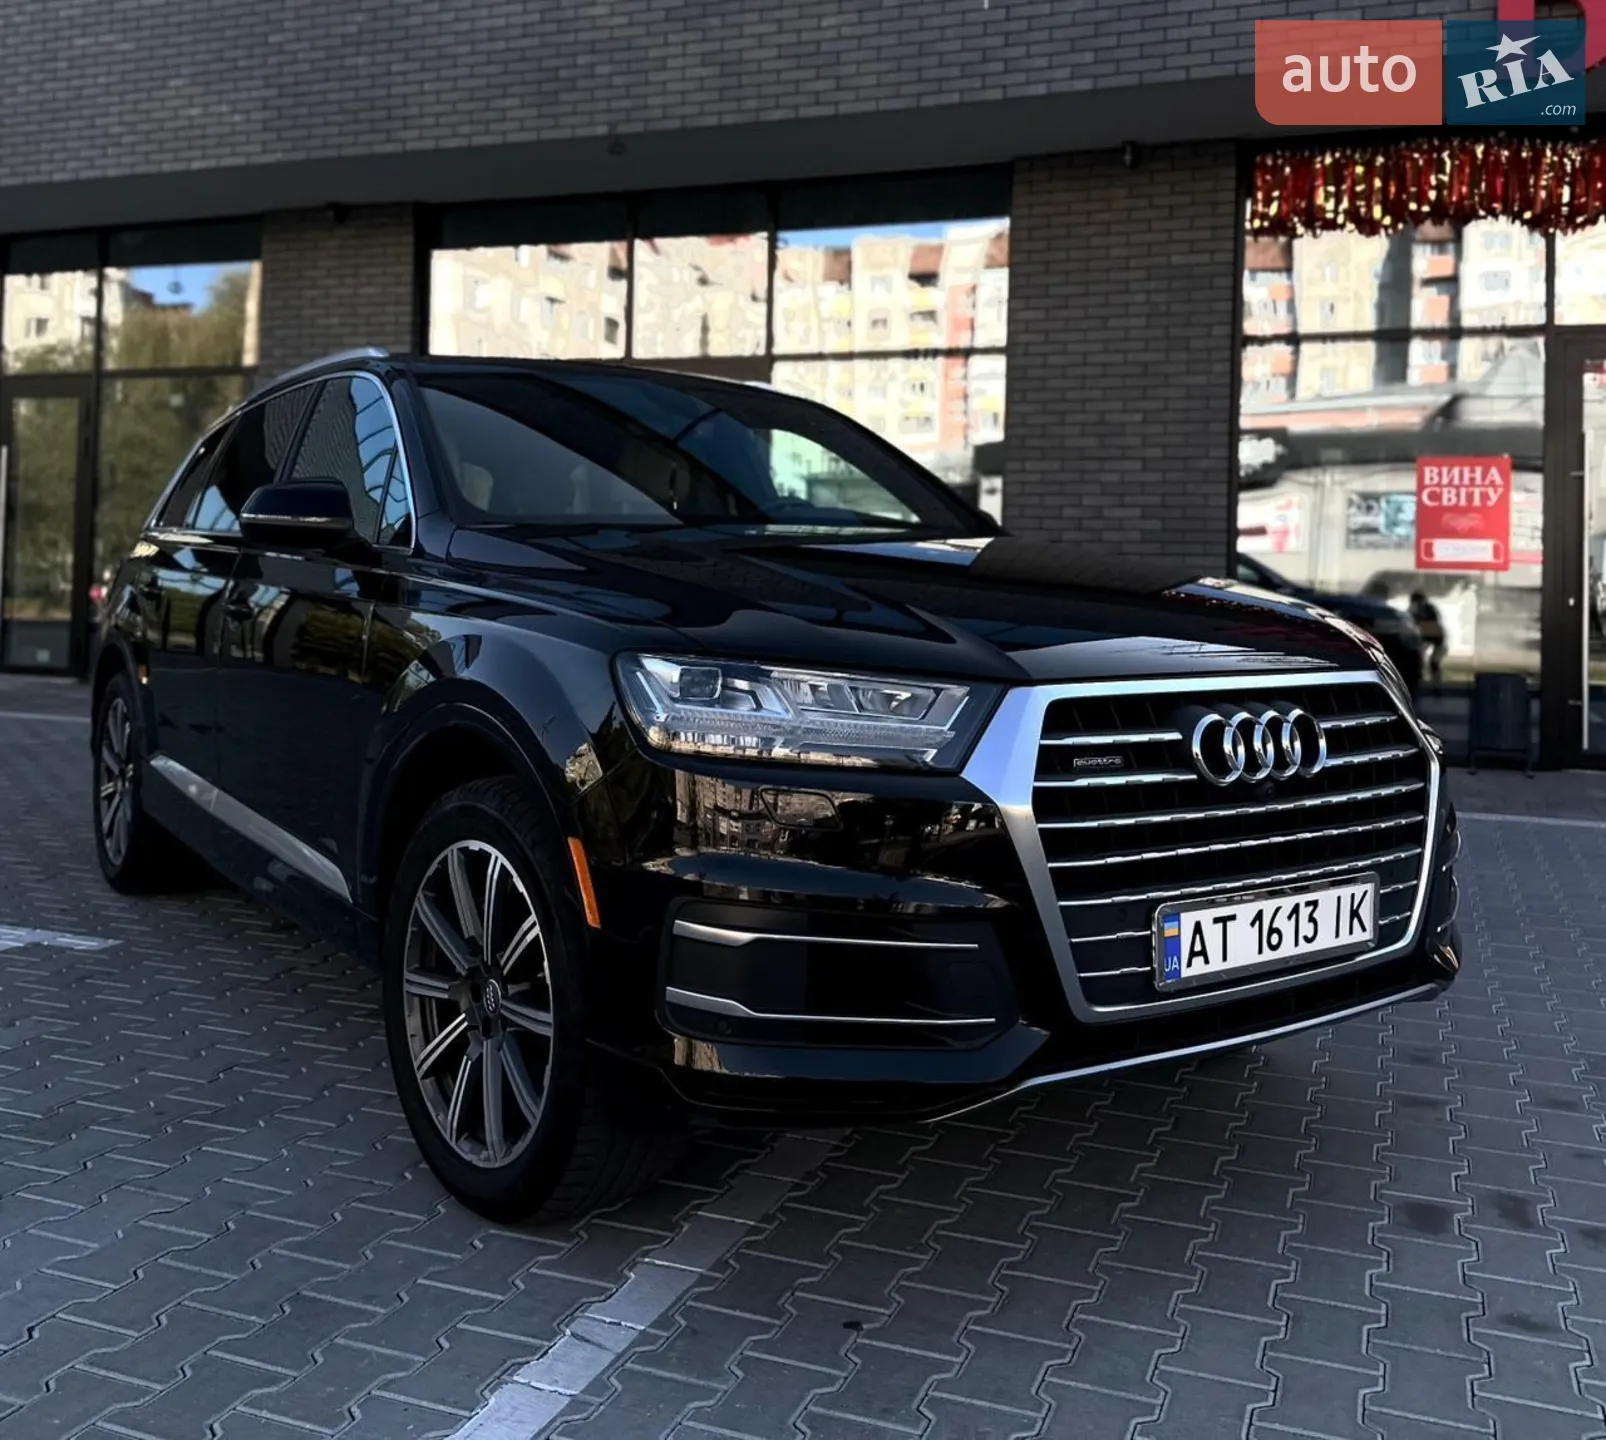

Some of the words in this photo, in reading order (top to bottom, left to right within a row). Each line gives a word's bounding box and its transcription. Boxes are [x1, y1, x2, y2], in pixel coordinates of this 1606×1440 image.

[1423, 466, 1504, 486] ВИНА
[1421, 486, 1504, 507] СВІТУ
[1186, 913, 1237, 968] AT
[1249, 898, 1320, 956] 1613
[1334, 889, 1369, 939] IK
[1163, 955, 1180, 972] UA
